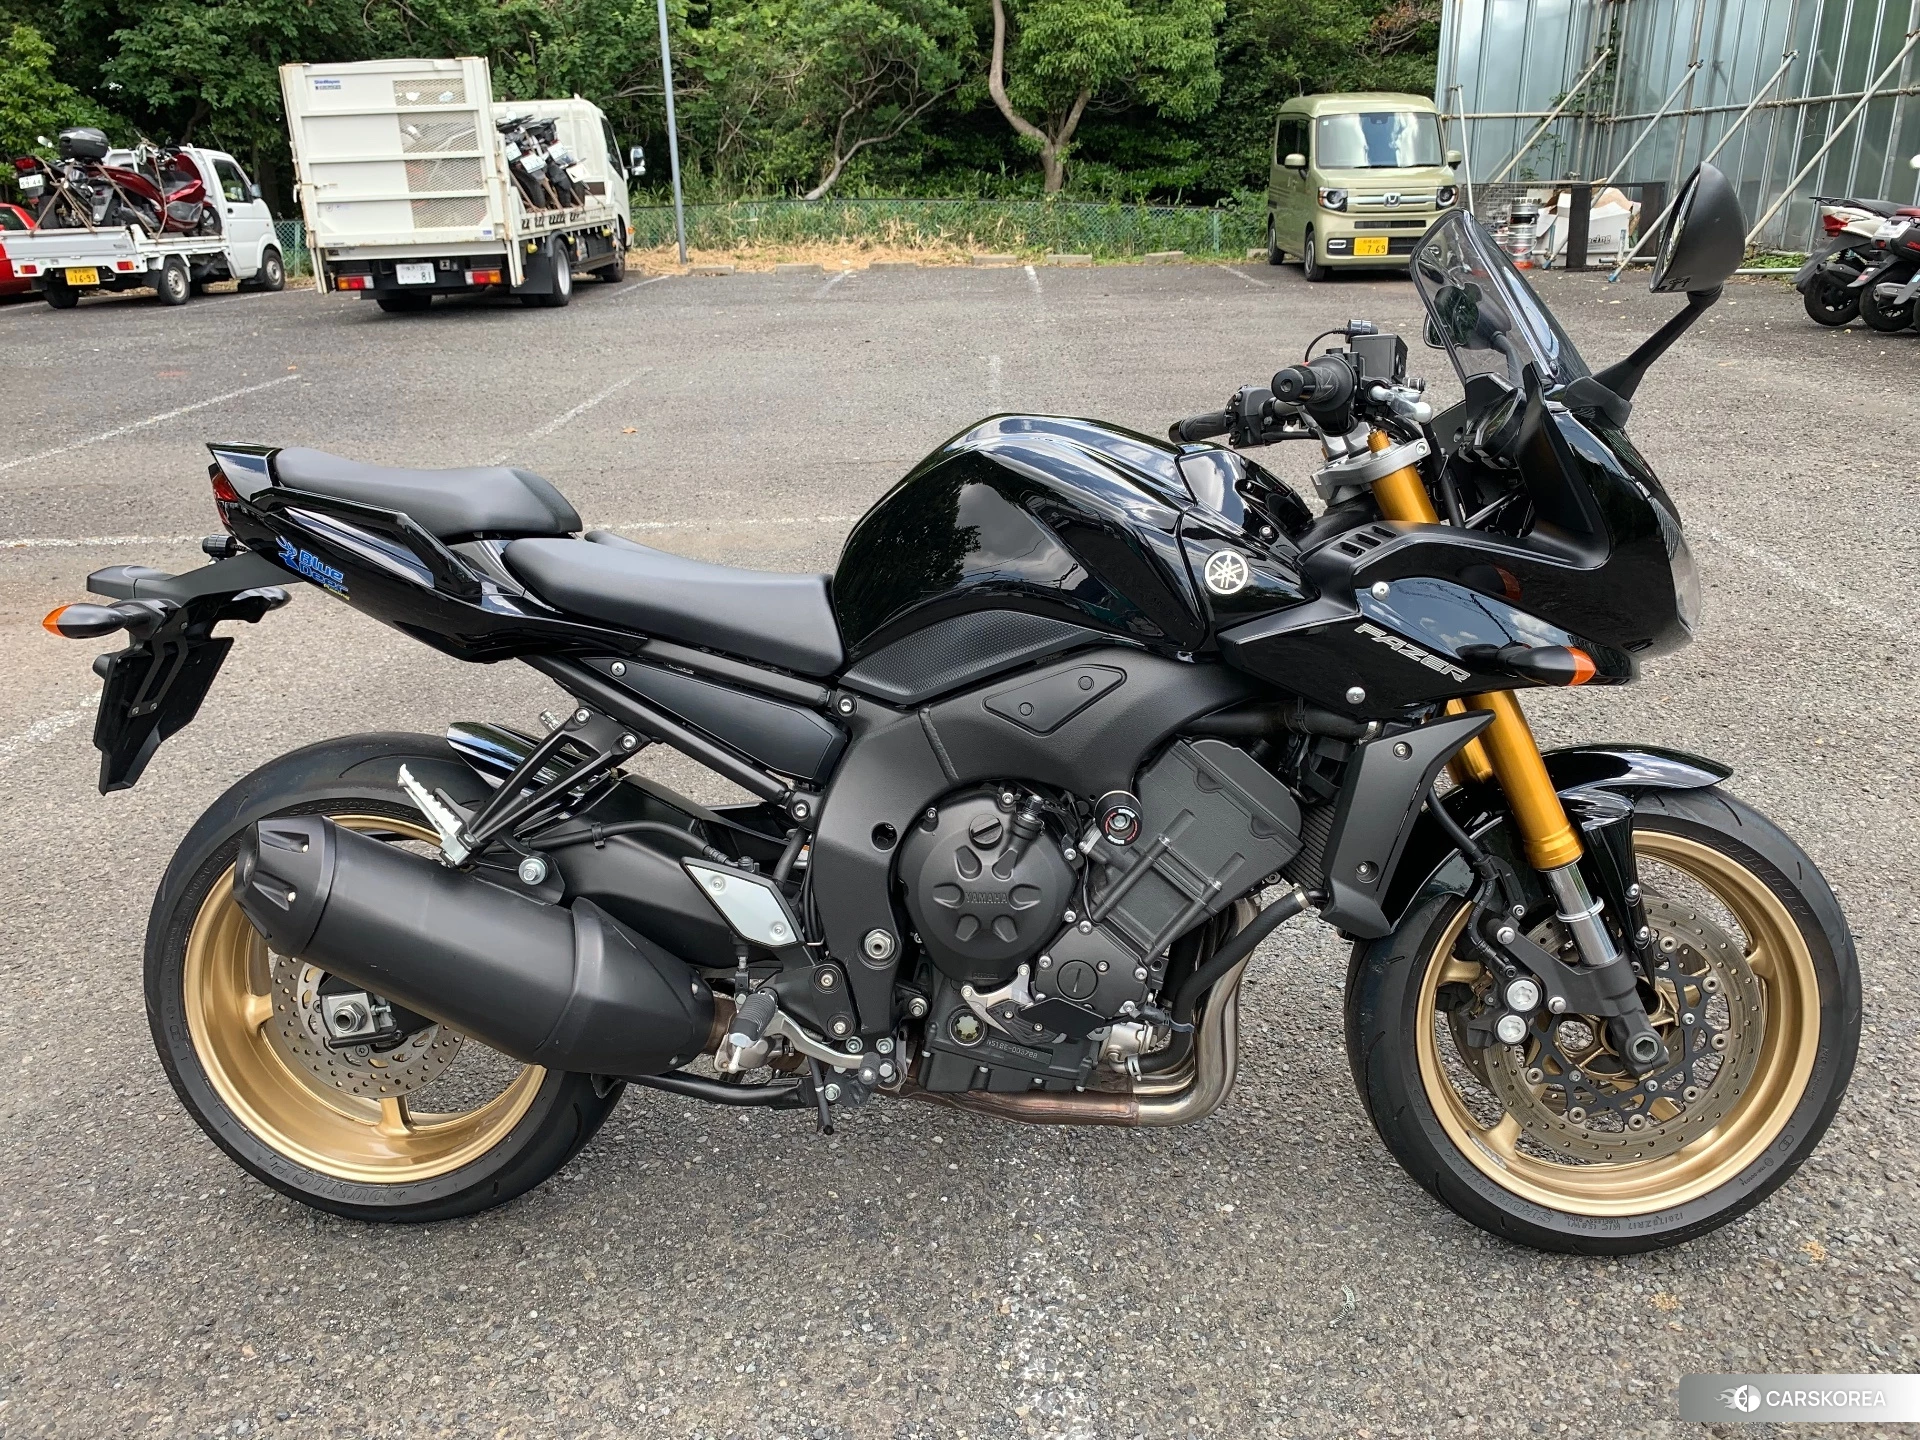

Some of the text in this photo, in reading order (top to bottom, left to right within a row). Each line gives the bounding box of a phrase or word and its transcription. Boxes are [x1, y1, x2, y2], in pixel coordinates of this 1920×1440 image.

[299, 549, 344, 583] Blue
[1354, 622, 1472, 683] FAZER
[965, 891, 1008, 904] YAMAHA
